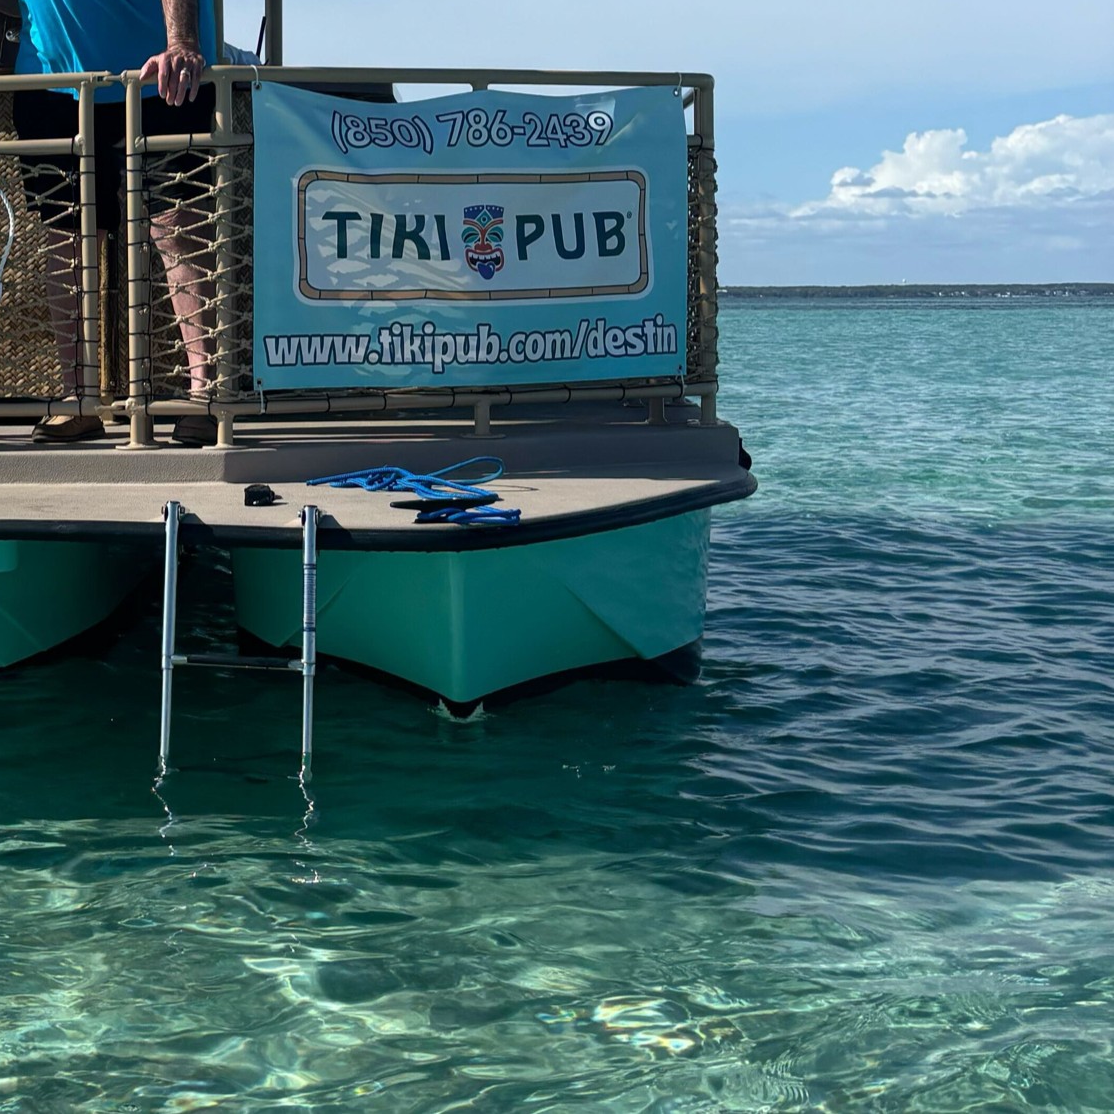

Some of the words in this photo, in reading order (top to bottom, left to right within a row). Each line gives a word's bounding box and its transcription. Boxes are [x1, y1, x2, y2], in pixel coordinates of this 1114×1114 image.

[332, 110, 434, 154] (850)
[436, 109, 614, 148] 786-2439
[322, 211, 451, 261] TIKI
[265, 314, 678, 373] www.tikipub.com/destin
